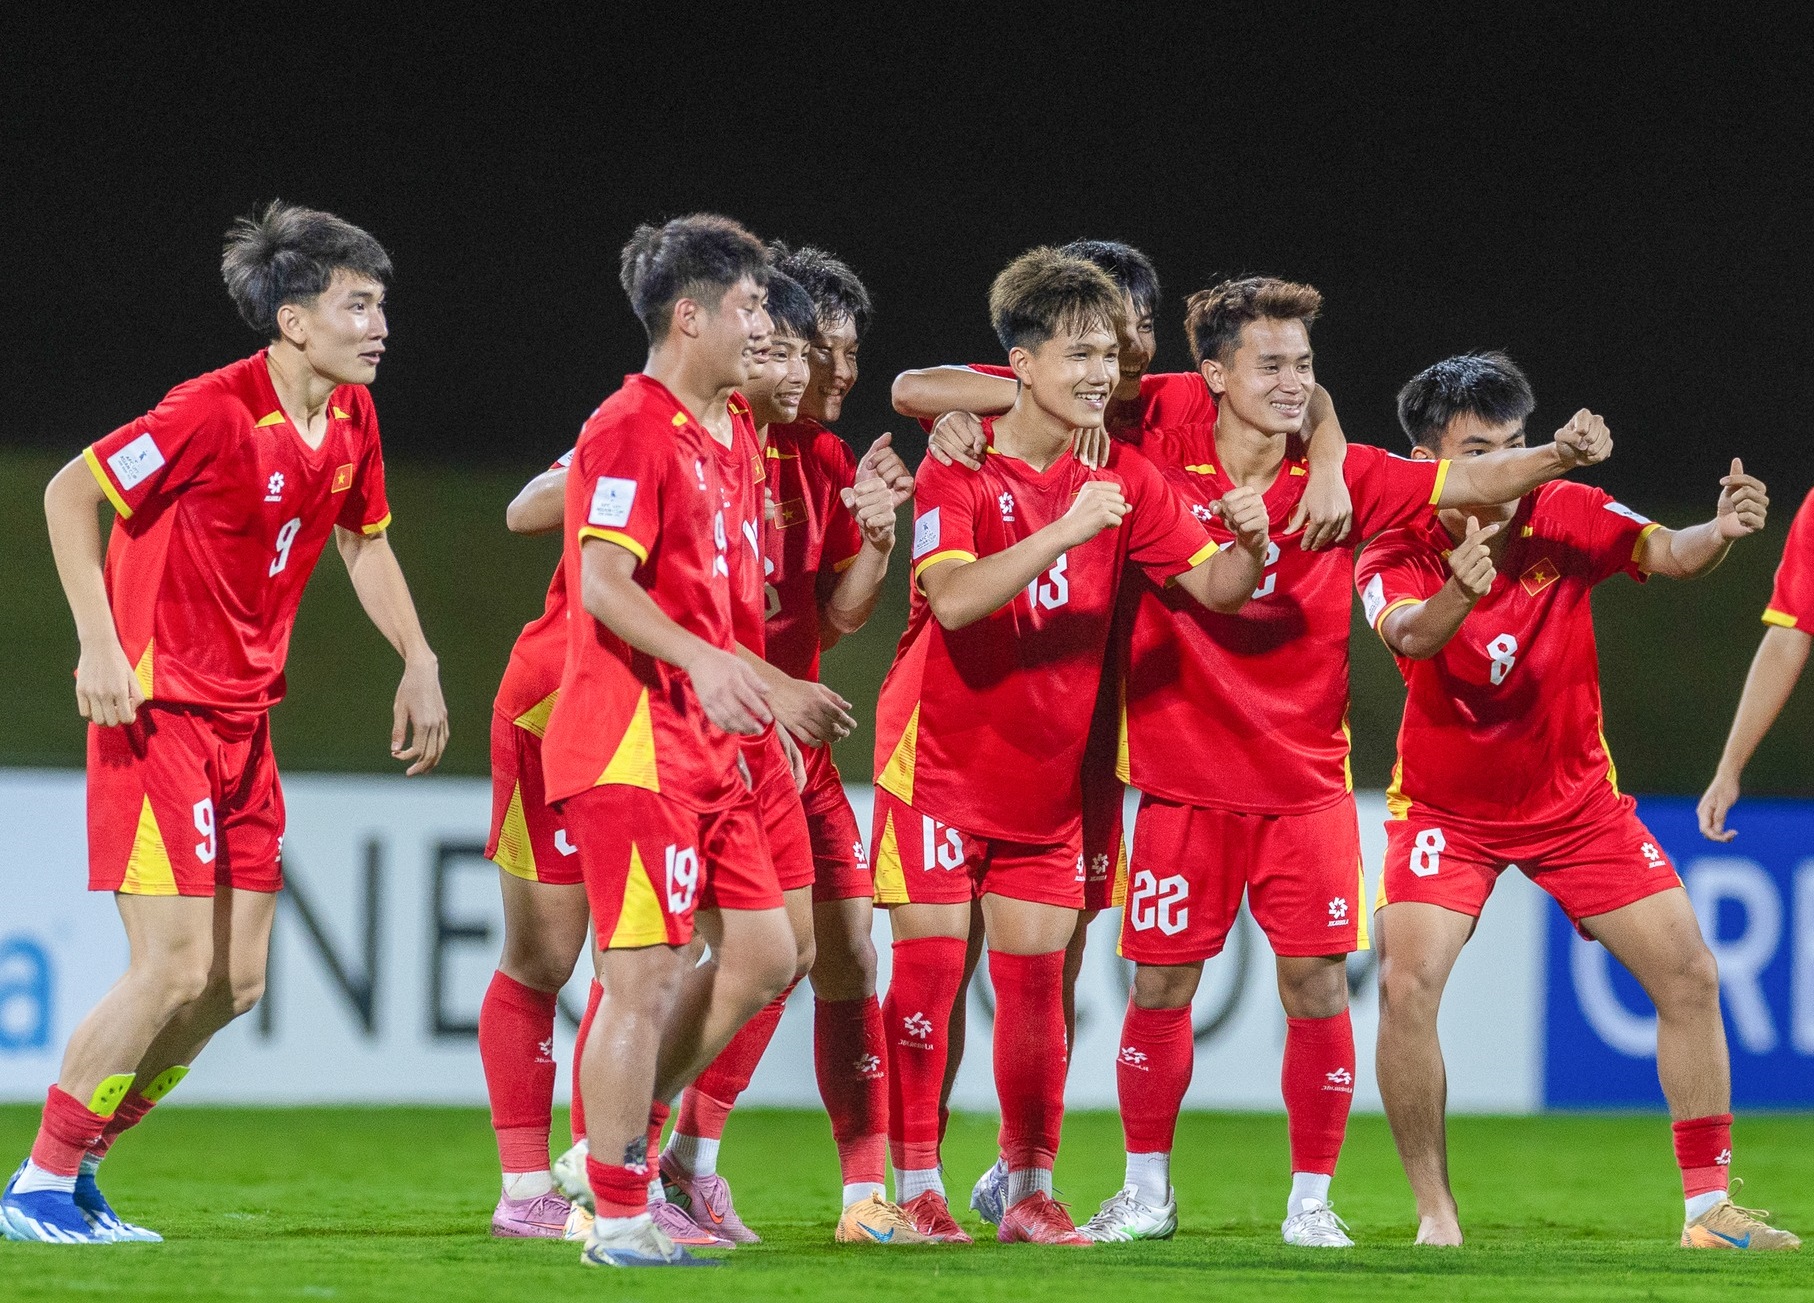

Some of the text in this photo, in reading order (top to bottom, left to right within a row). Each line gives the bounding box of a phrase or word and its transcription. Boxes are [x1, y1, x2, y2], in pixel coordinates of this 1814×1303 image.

[268, 517, 301, 578] 9
[1486, 633, 1518, 686] 8
[193, 797, 216, 864] 9
[922, 814, 965, 871] 13
[1409, 827, 1447, 878] 8
[665, 843, 699, 914] 19
[1131, 869, 1189, 936] 22
